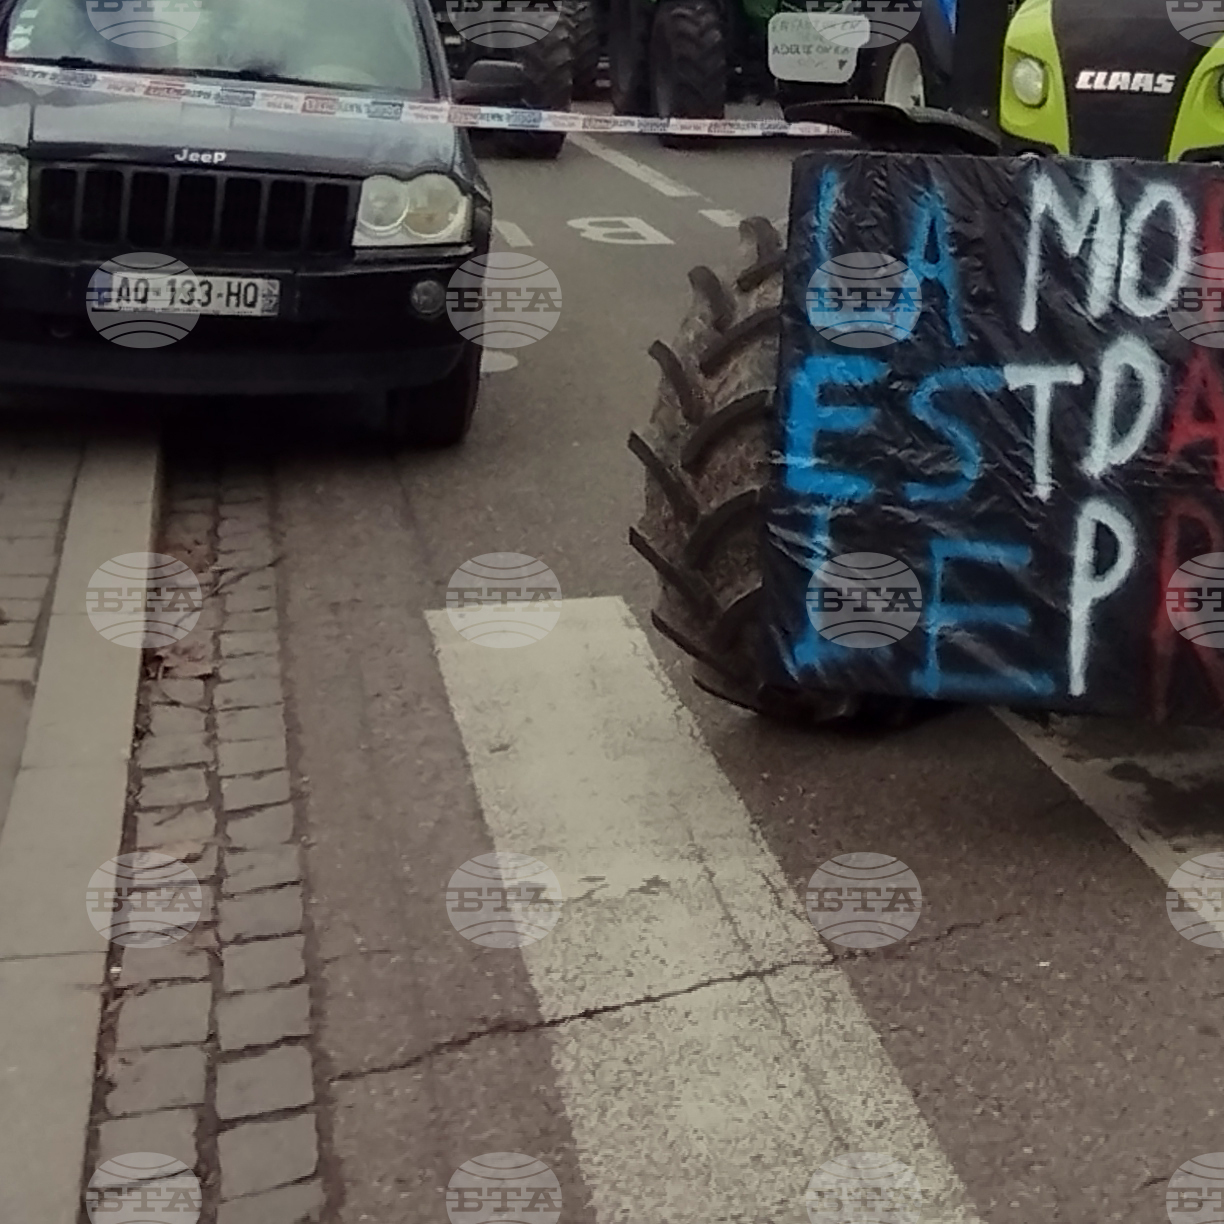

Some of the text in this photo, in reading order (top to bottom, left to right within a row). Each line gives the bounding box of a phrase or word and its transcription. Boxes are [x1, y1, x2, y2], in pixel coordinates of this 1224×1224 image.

[174, 148, 228, 164] Jeep
[1075, 70, 1177, 94] CLAAS
[806, 164, 968, 347] LA
[783, 350, 1090, 503] EST
[790, 506, 1055, 697] LE
